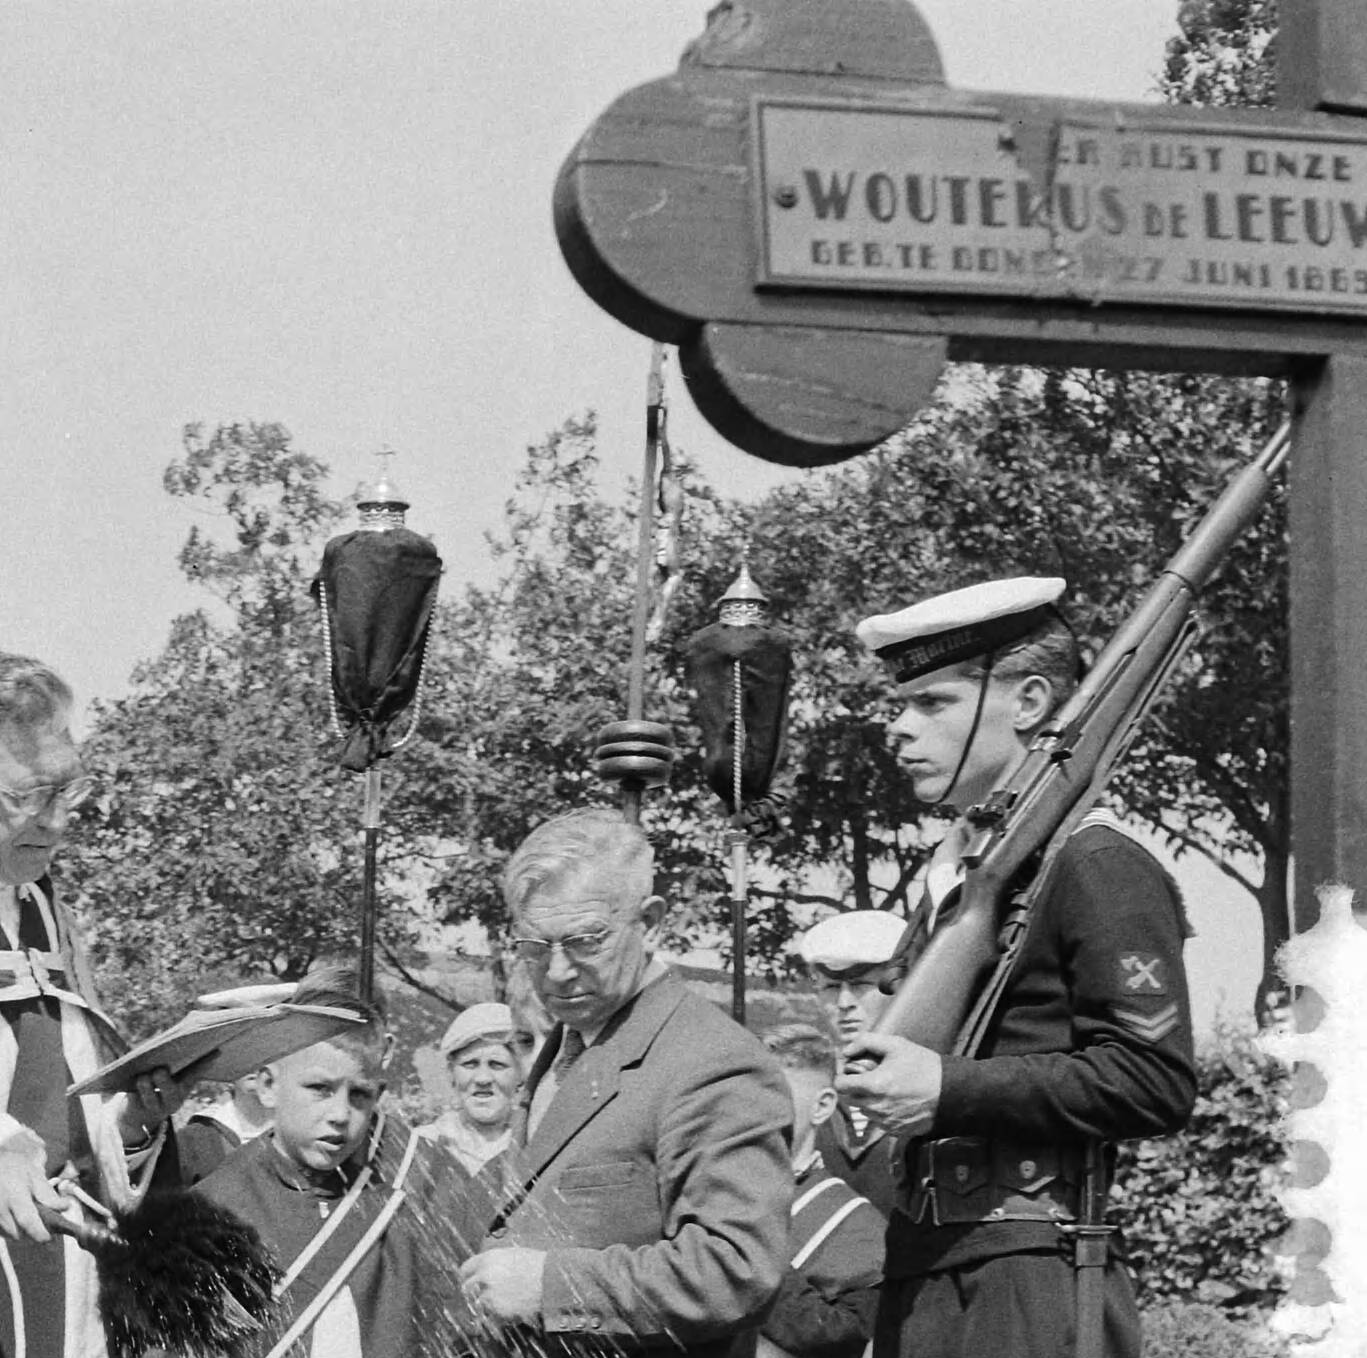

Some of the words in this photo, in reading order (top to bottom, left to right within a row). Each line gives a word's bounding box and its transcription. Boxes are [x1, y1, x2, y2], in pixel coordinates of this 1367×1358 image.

[1118, 141, 1225, 173] RUST
[1244, 149, 1353, 182] ONZE
[1143, 201, 1190, 238] DE
[1183, 257, 1271, 289] JUNI
